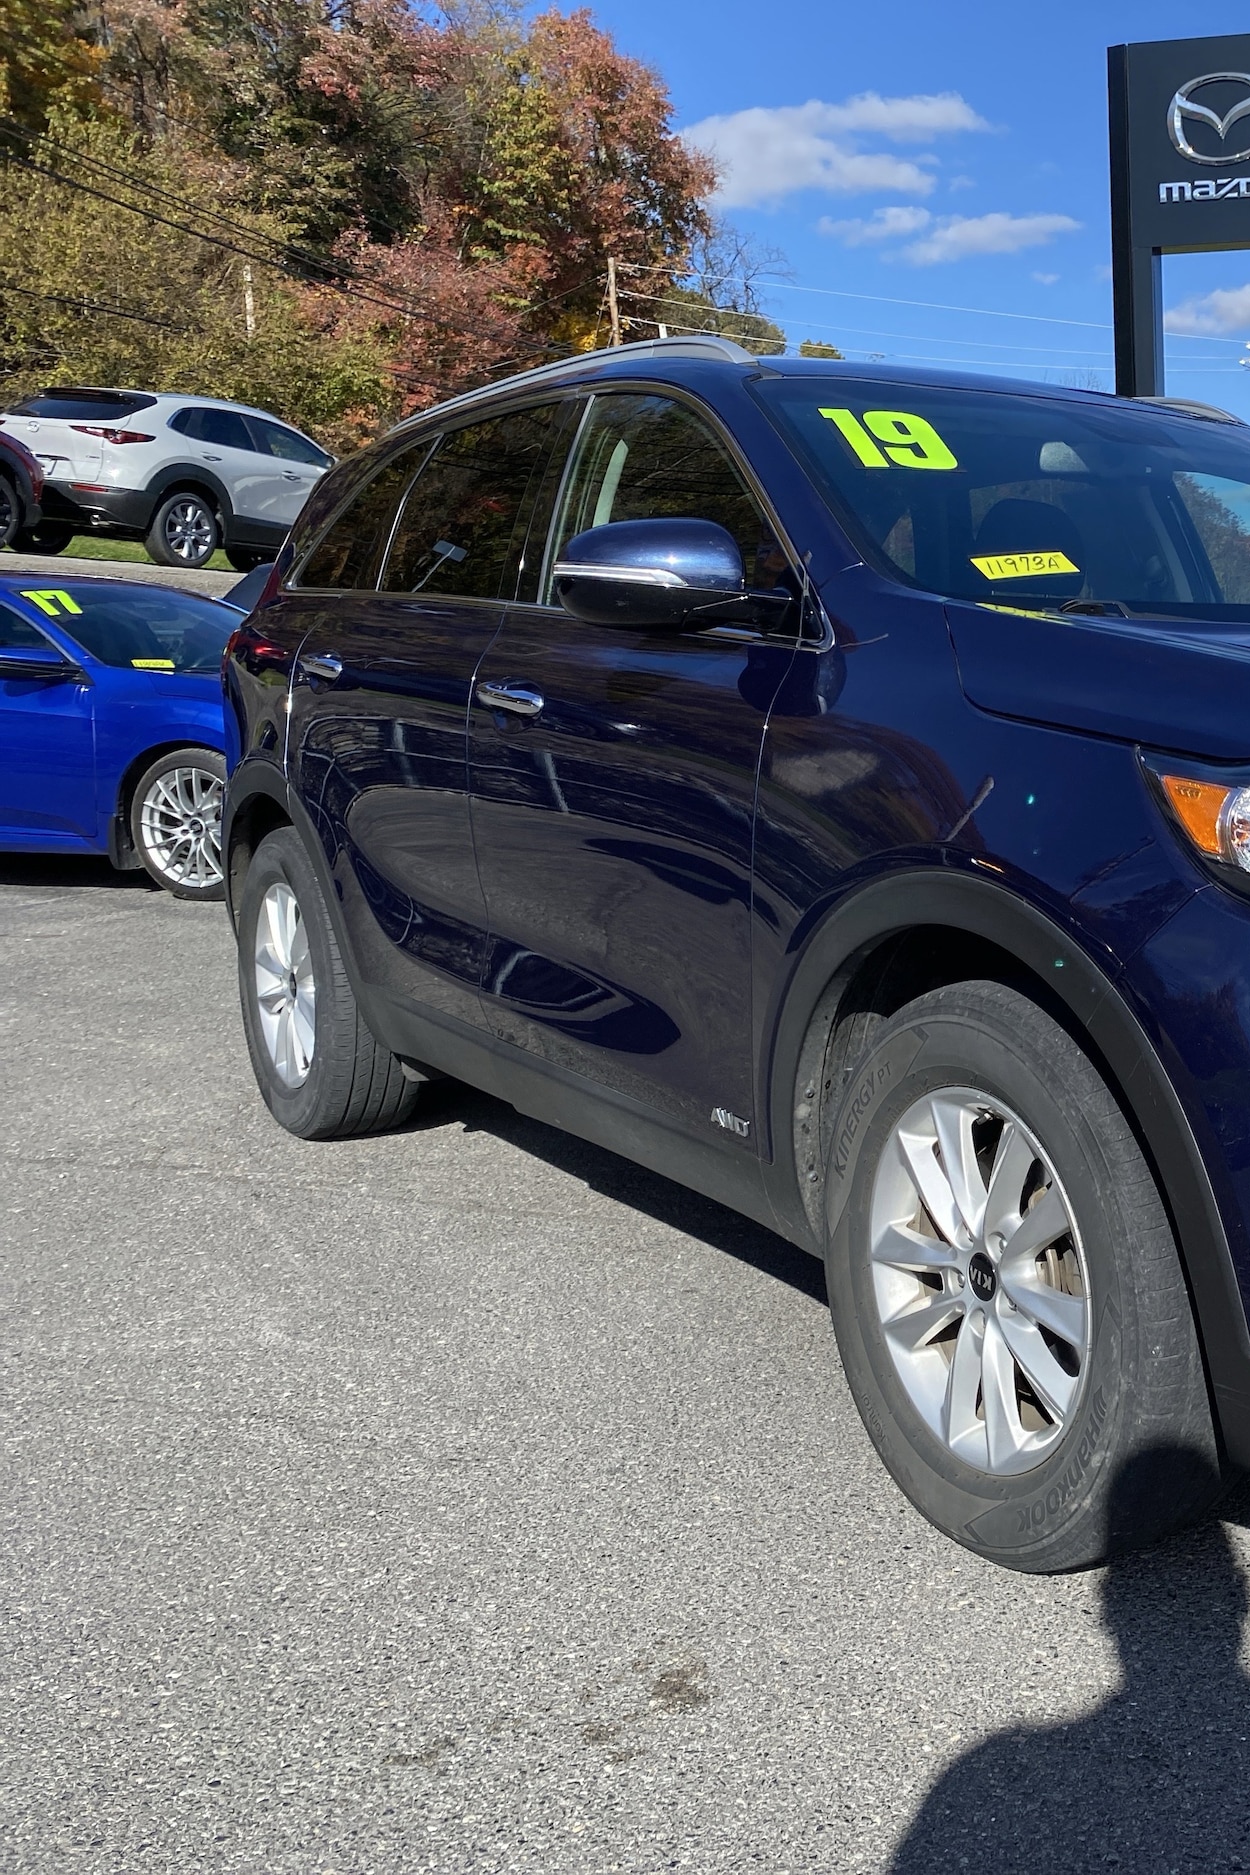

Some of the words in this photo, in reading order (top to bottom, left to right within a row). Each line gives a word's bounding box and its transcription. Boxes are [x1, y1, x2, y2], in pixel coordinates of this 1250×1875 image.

[817, 408, 958, 470] 19
[985, 556, 1060, 576] 11973A
[20, 590, 83, 616] 17
[877, 1061, 892, 1085] PT
[710, 1107, 750, 1137] AWD
[969, 1265, 993, 1292] KIA
